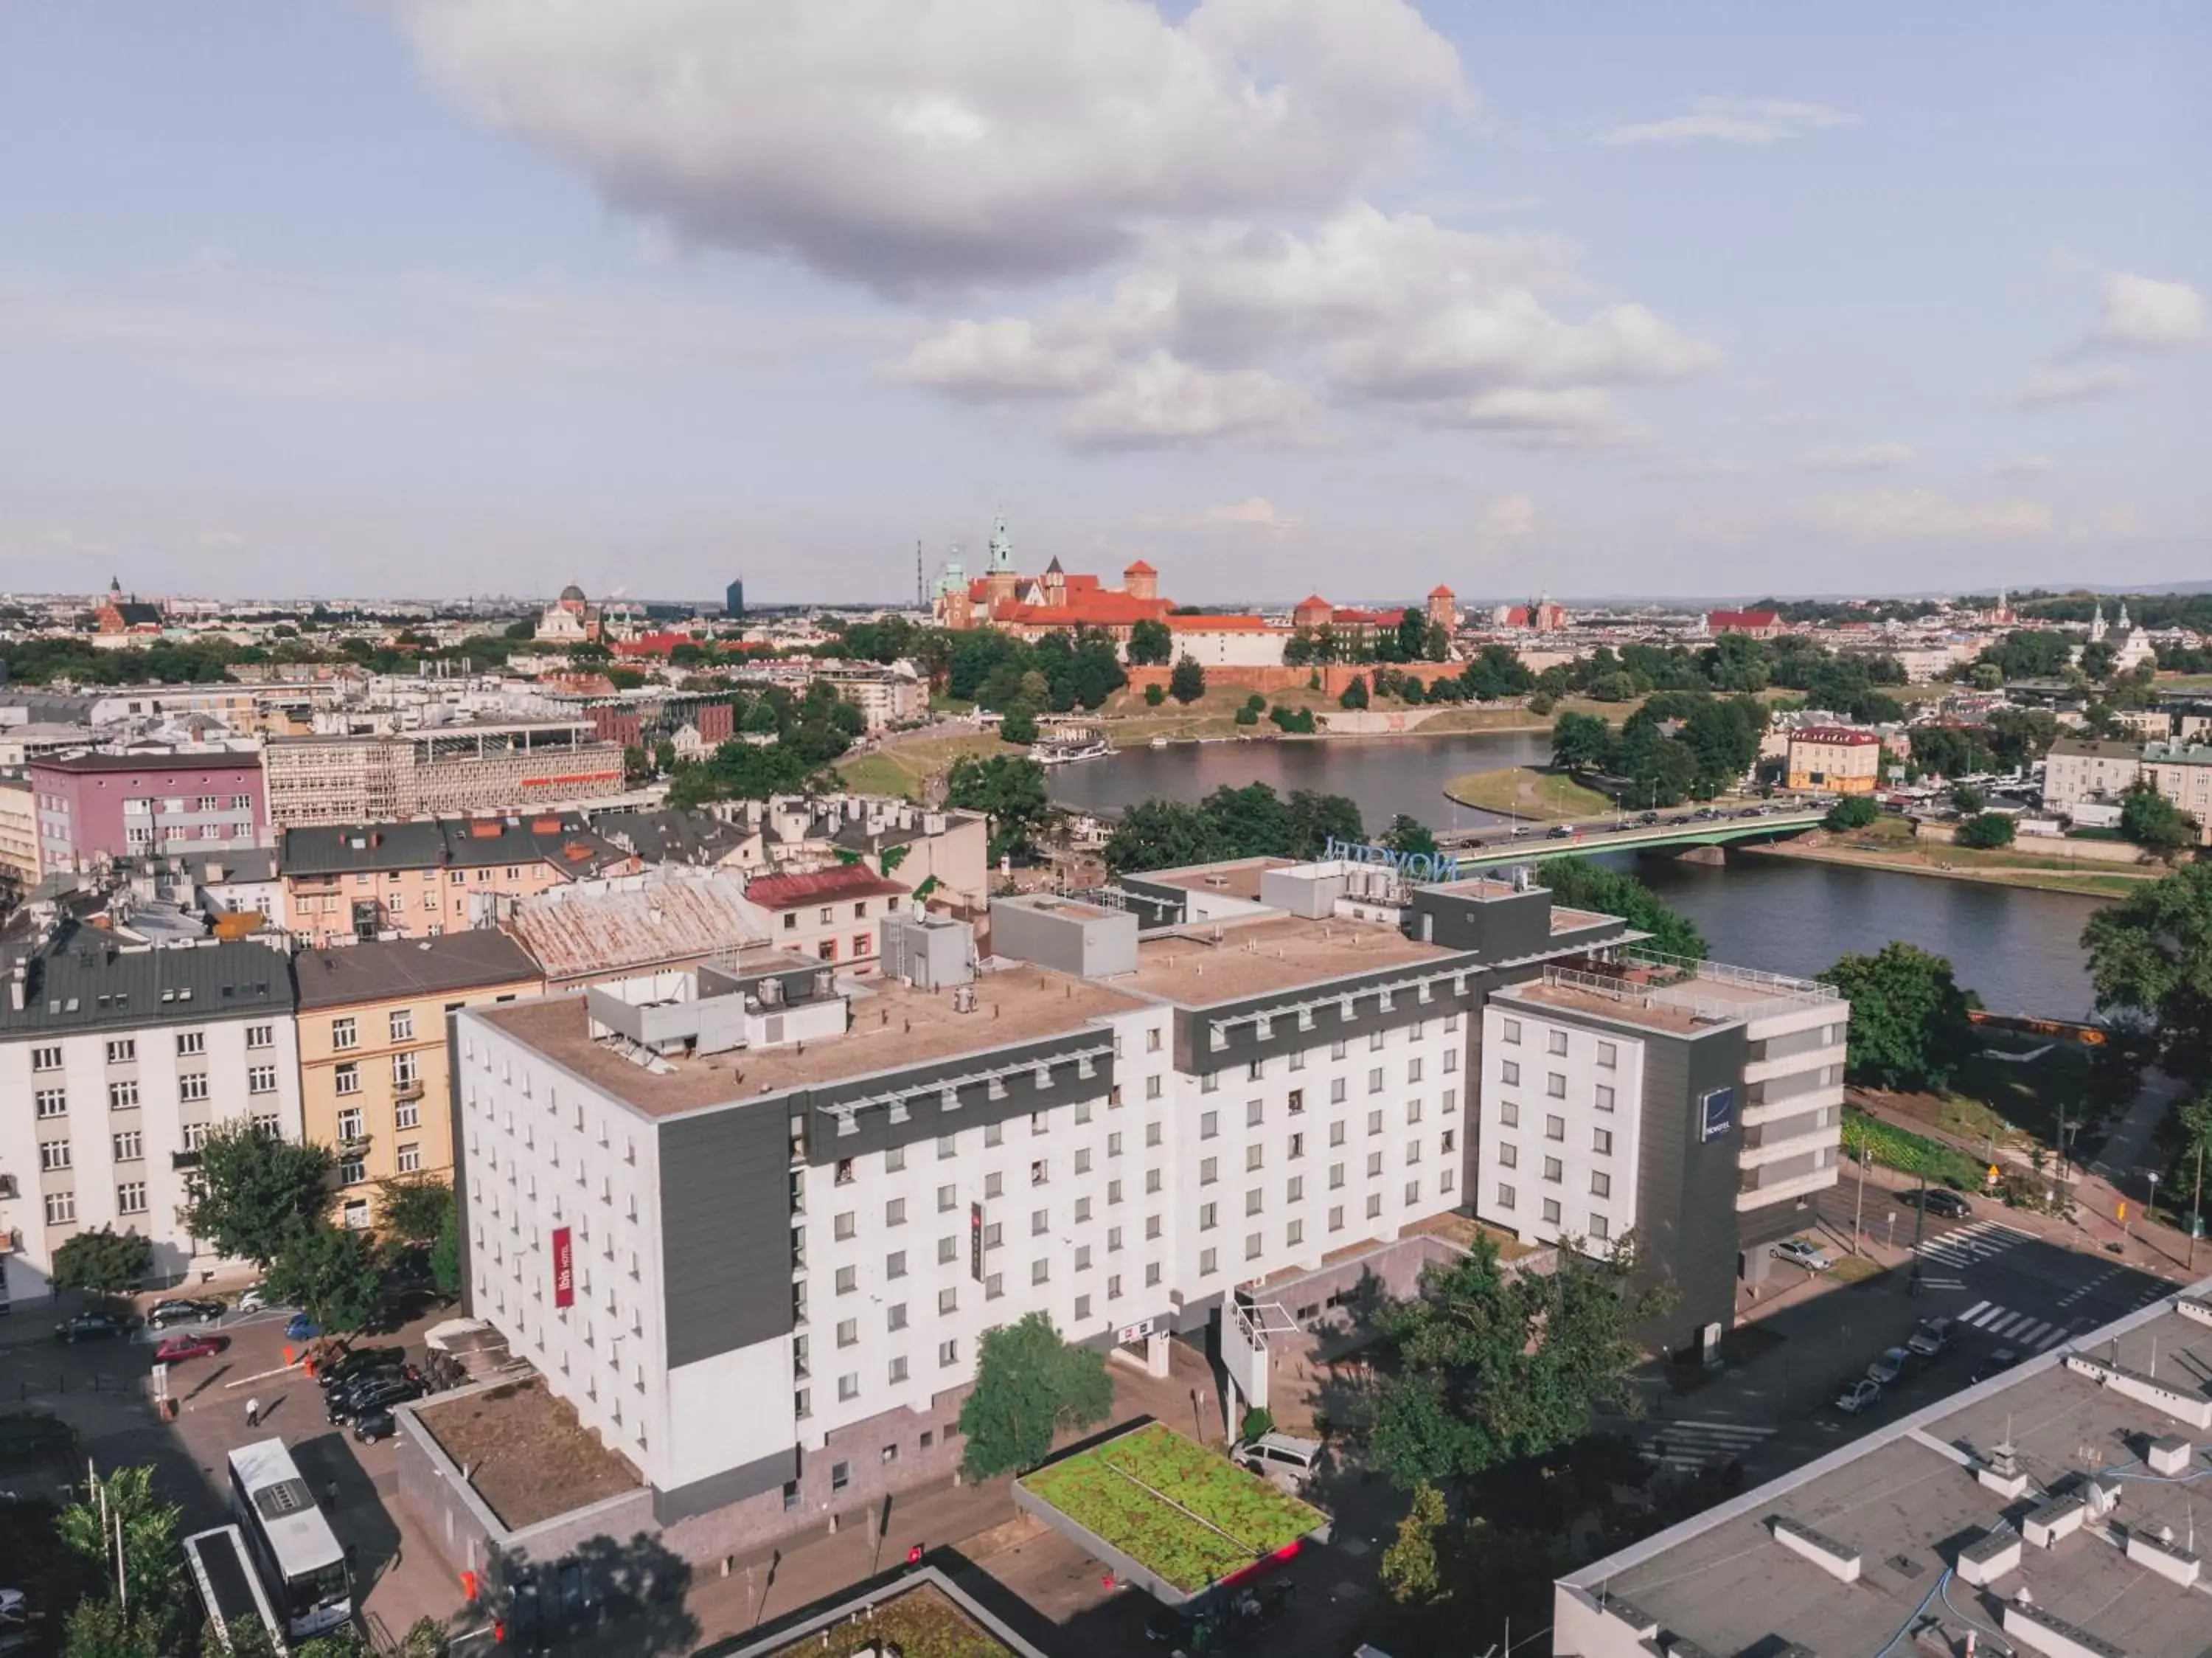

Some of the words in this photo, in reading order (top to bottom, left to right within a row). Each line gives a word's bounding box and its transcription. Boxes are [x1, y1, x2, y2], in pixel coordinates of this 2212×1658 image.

[1705, 1121, 1730, 1134] NOVOTEL
[561, 1243, 570, 1267] HOTEL
[558, 1269, 571, 1291] ibis
